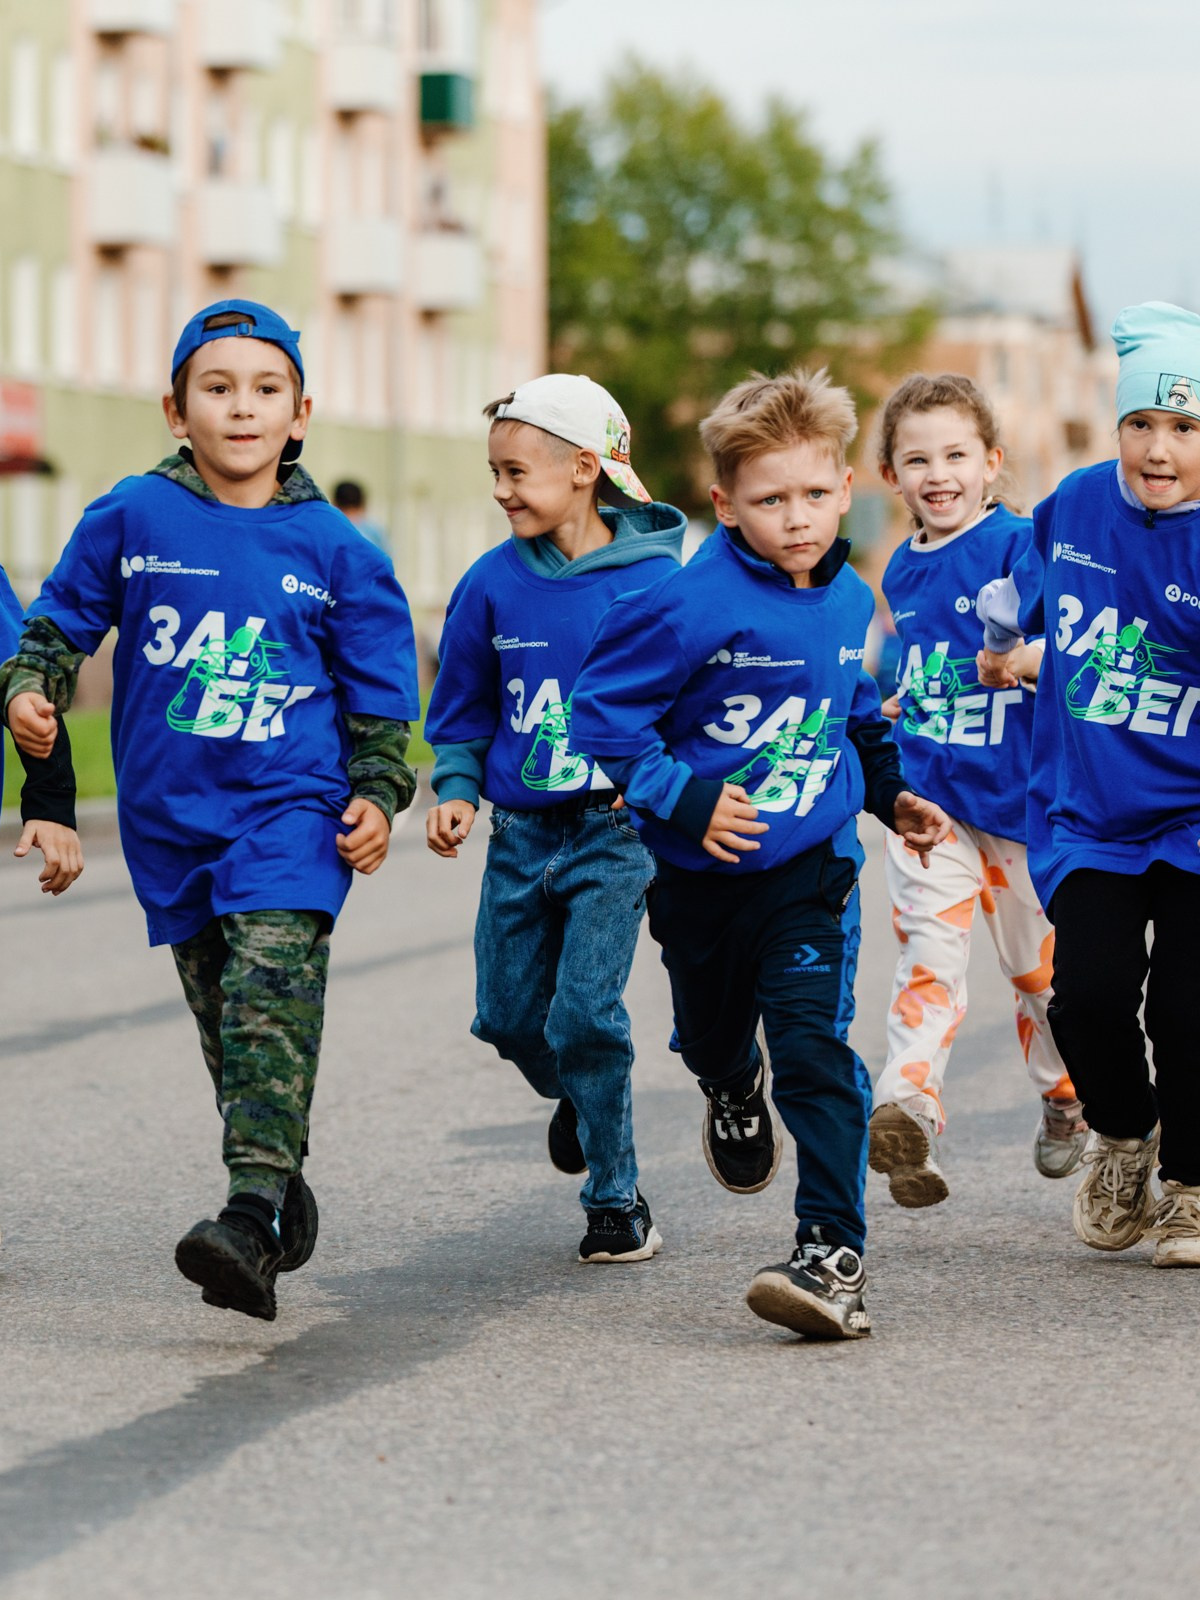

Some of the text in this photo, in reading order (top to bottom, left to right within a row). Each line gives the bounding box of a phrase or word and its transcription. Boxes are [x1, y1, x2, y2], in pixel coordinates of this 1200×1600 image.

[143, 605, 266, 677] ЗА!
[1055, 594, 1148, 669] ЗА!
[896, 641, 950, 700] А!
[191, 678, 316, 742] БЕГ
[507, 678, 568, 734] ЗА
[703, 694, 831, 756] ЗА!
[1084, 671, 1200, 737] БЕГ
